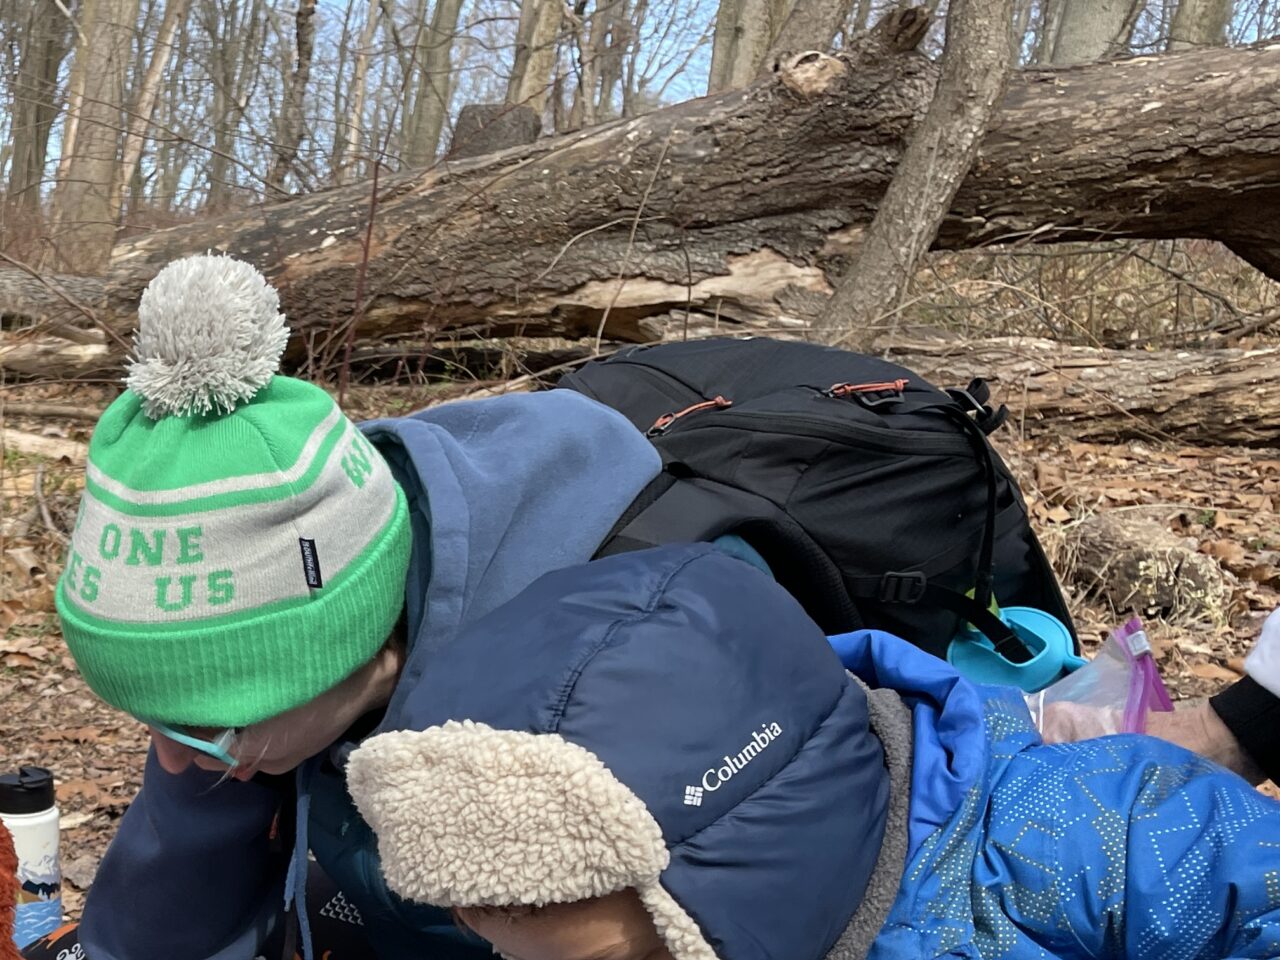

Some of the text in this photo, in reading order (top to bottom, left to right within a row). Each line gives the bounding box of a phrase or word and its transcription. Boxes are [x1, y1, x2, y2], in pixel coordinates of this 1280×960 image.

[99, 523, 205, 567] ONE
[67, 551, 235, 612] ES US
[702, 722, 783, 791] Columbia
